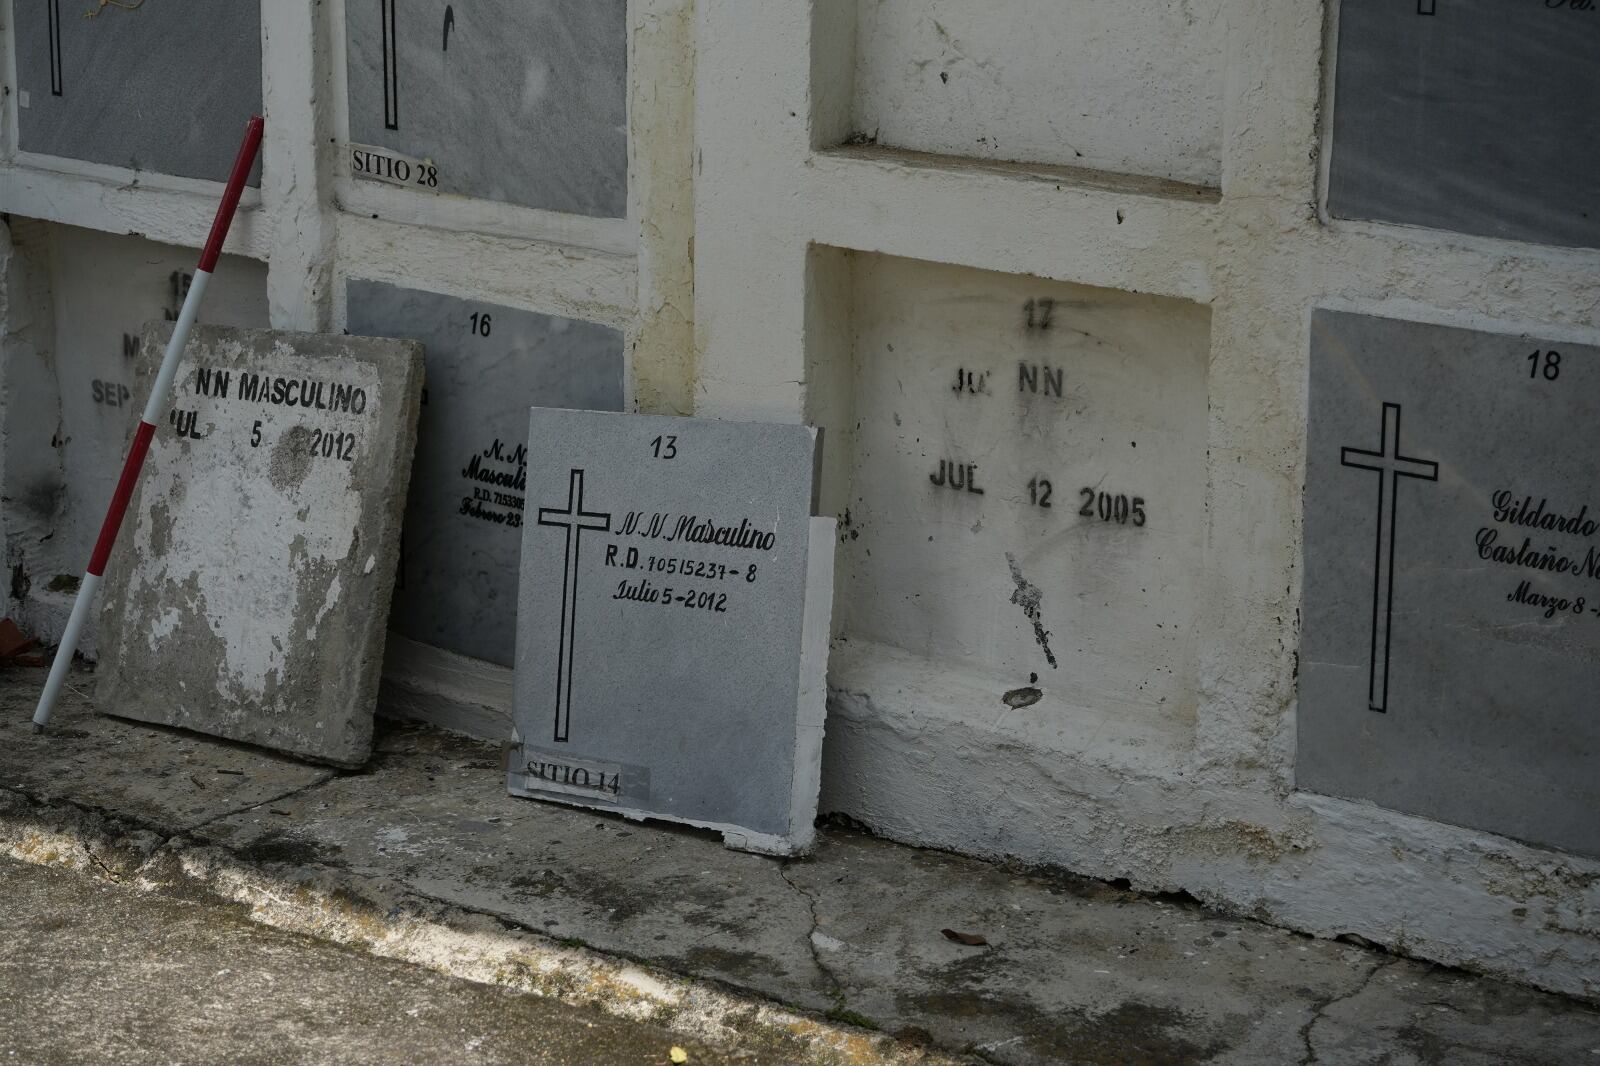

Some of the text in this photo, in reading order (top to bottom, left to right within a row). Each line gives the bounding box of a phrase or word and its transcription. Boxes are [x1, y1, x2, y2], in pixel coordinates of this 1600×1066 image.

[352, 149, 438, 188] SITIO 28
[469, 311, 492, 337] 16
[1018, 362, 1063, 398] NN
[1527, 349, 1561, 381] 18
[195, 367, 367, 415] NN MASCULINO
[250, 420, 263, 448] 5
[309, 428, 356, 462] 2012
[650, 435, 678, 459] 13
[462, 454, 527, 491] Masculi
[929, 459, 1146, 528] JUL 12 2005
[1492, 489, 1600, 537] Gildardo
[667, 514, 776, 551] Masculino
[1475, 527, 1573, 573] Castaño
[1507, 580, 1573, 619] Marzo
[526, 760, 621, 795] SITIO 14
